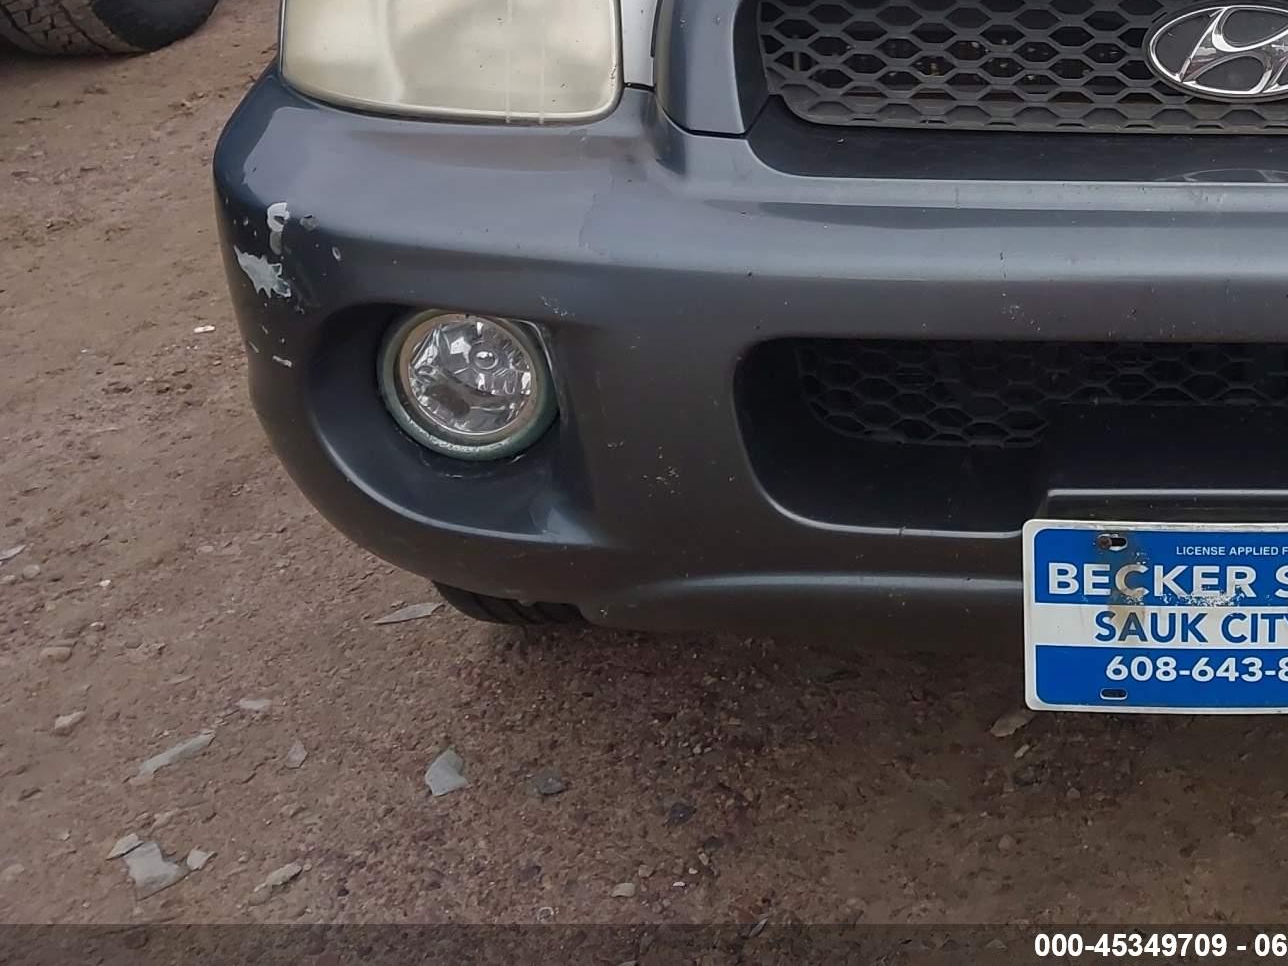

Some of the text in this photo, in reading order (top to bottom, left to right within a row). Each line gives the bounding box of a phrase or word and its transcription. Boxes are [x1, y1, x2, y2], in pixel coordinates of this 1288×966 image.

[1176, 546, 1226, 556] LICENSE
[1229, 546, 1278, 556] APPLIED
[1048, 563, 1257, 598] BECKER
[1095, 611, 1208, 643] SAUK
